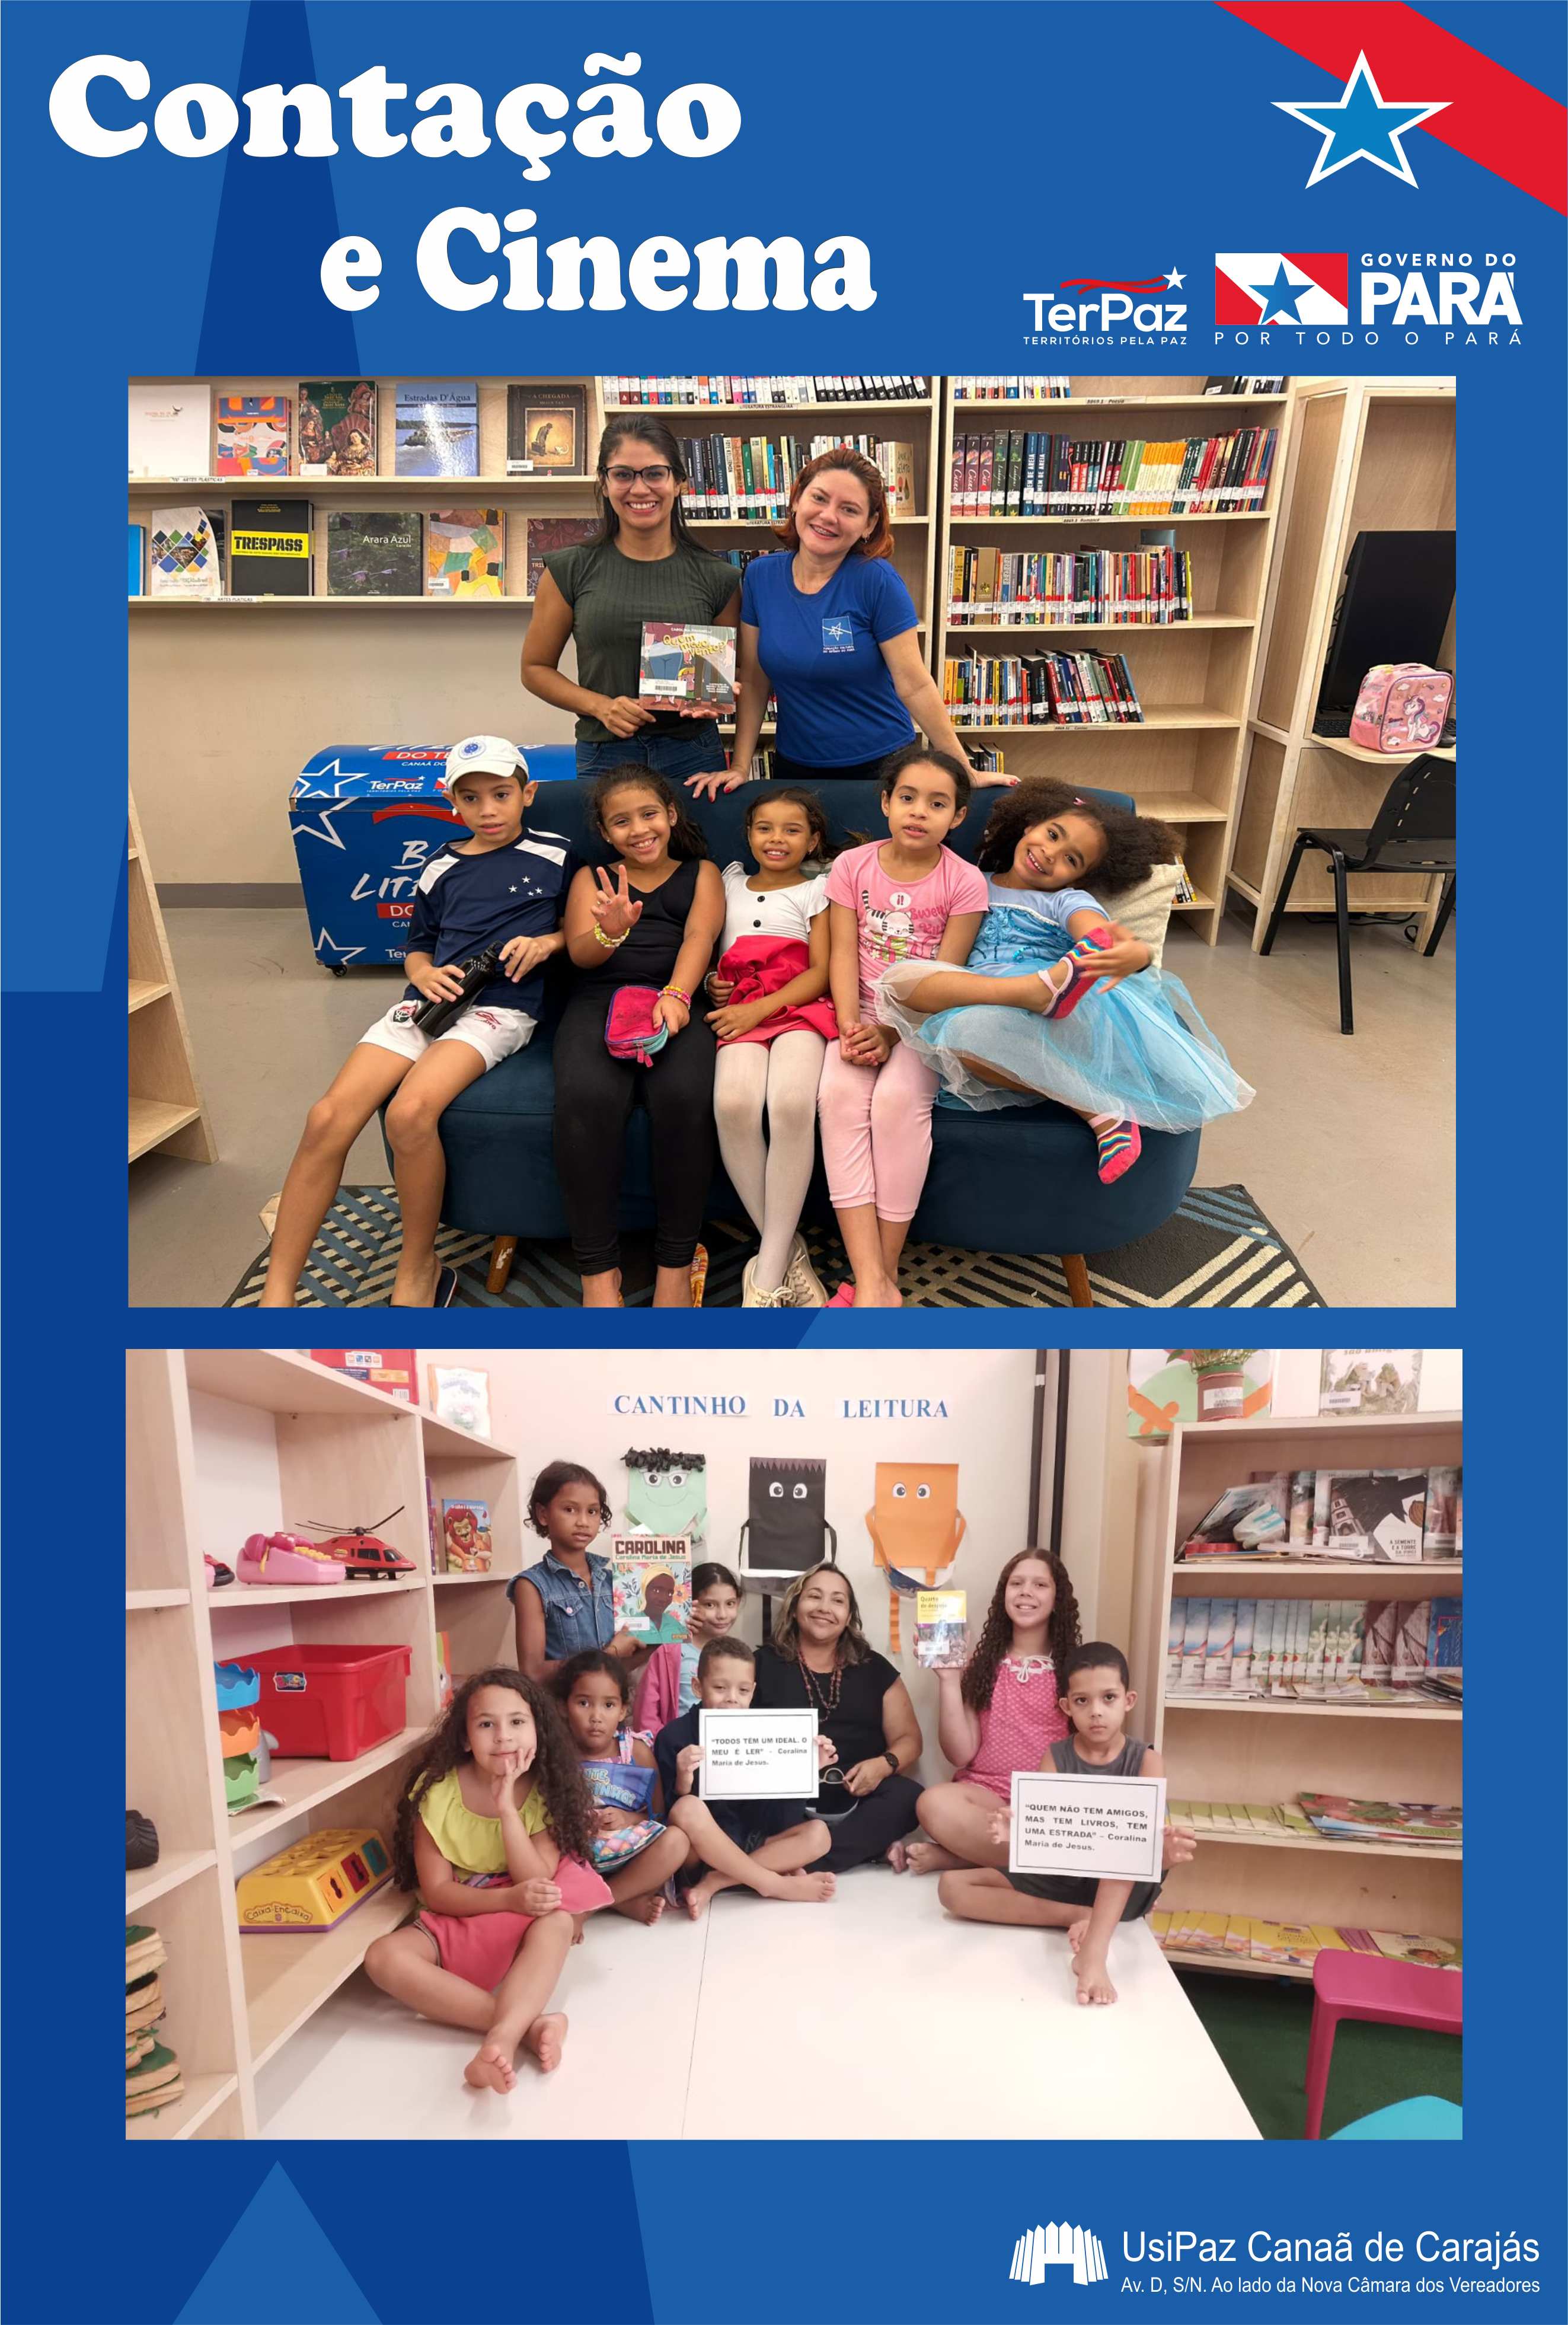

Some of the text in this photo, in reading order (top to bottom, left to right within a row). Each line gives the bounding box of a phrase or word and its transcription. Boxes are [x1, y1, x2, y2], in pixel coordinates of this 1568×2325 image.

[234, 536, 303, 552] TRESPASS
[363, 534, 411, 544] Arara Azul
[370, 780, 424, 790] TerPaz
[614, 1395, 949, 1418] CANTINHO DA LEITURA
[615, 1540, 686, 1554] CAROLINA
[1060, 1804, 1080, 1813] NÃO
[1106, 1809, 1148, 1819] AMIGOS,
[1081, 1819, 1119, 1829] LIVROS,
[1127, 1822, 1148, 1830] TEM
[1107, 1833, 1147, 1842] Coralina
[1025, 1839, 1049, 1848] Maria
[1066, 1842, 1095, 1851] Jesus.
